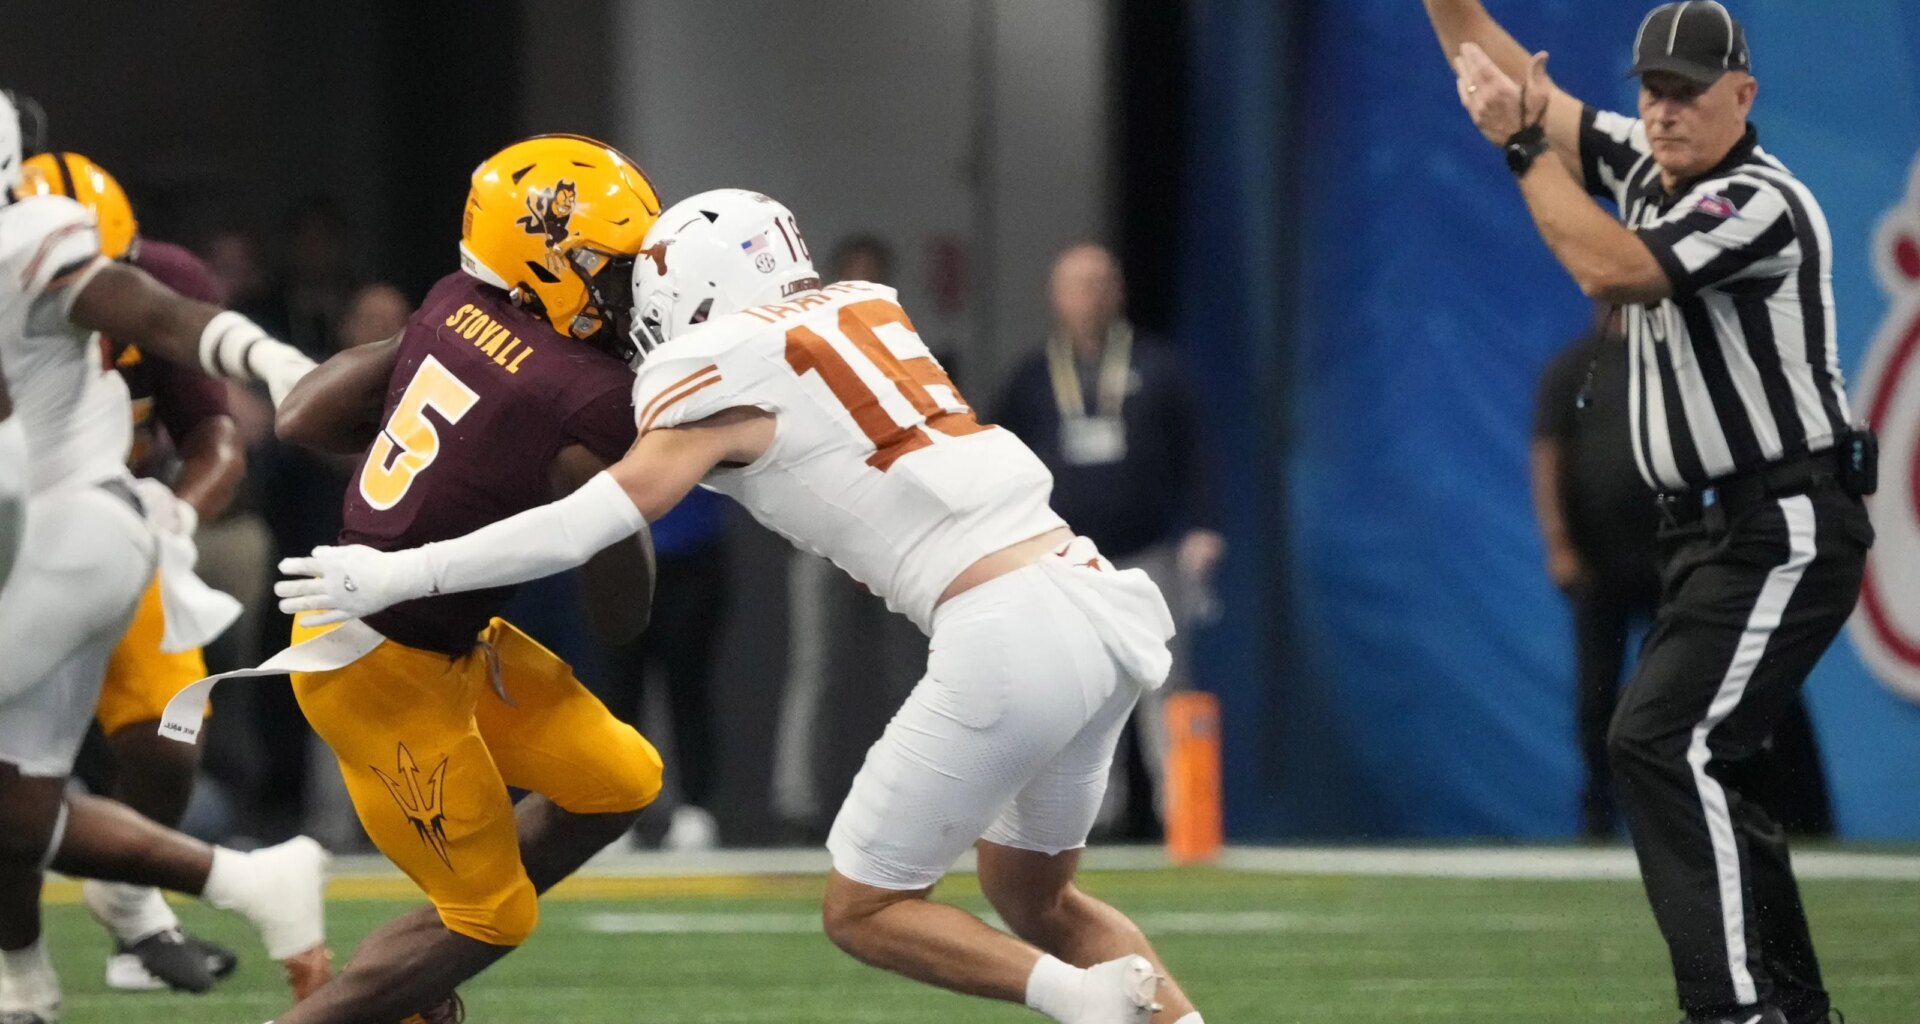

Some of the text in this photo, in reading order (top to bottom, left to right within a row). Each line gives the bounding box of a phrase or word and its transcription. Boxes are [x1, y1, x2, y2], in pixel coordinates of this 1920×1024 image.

[445, 303, 534, 374] STOVALL
[784, 298, 997, 473] 16
[359, 353, 481, 511] 5
